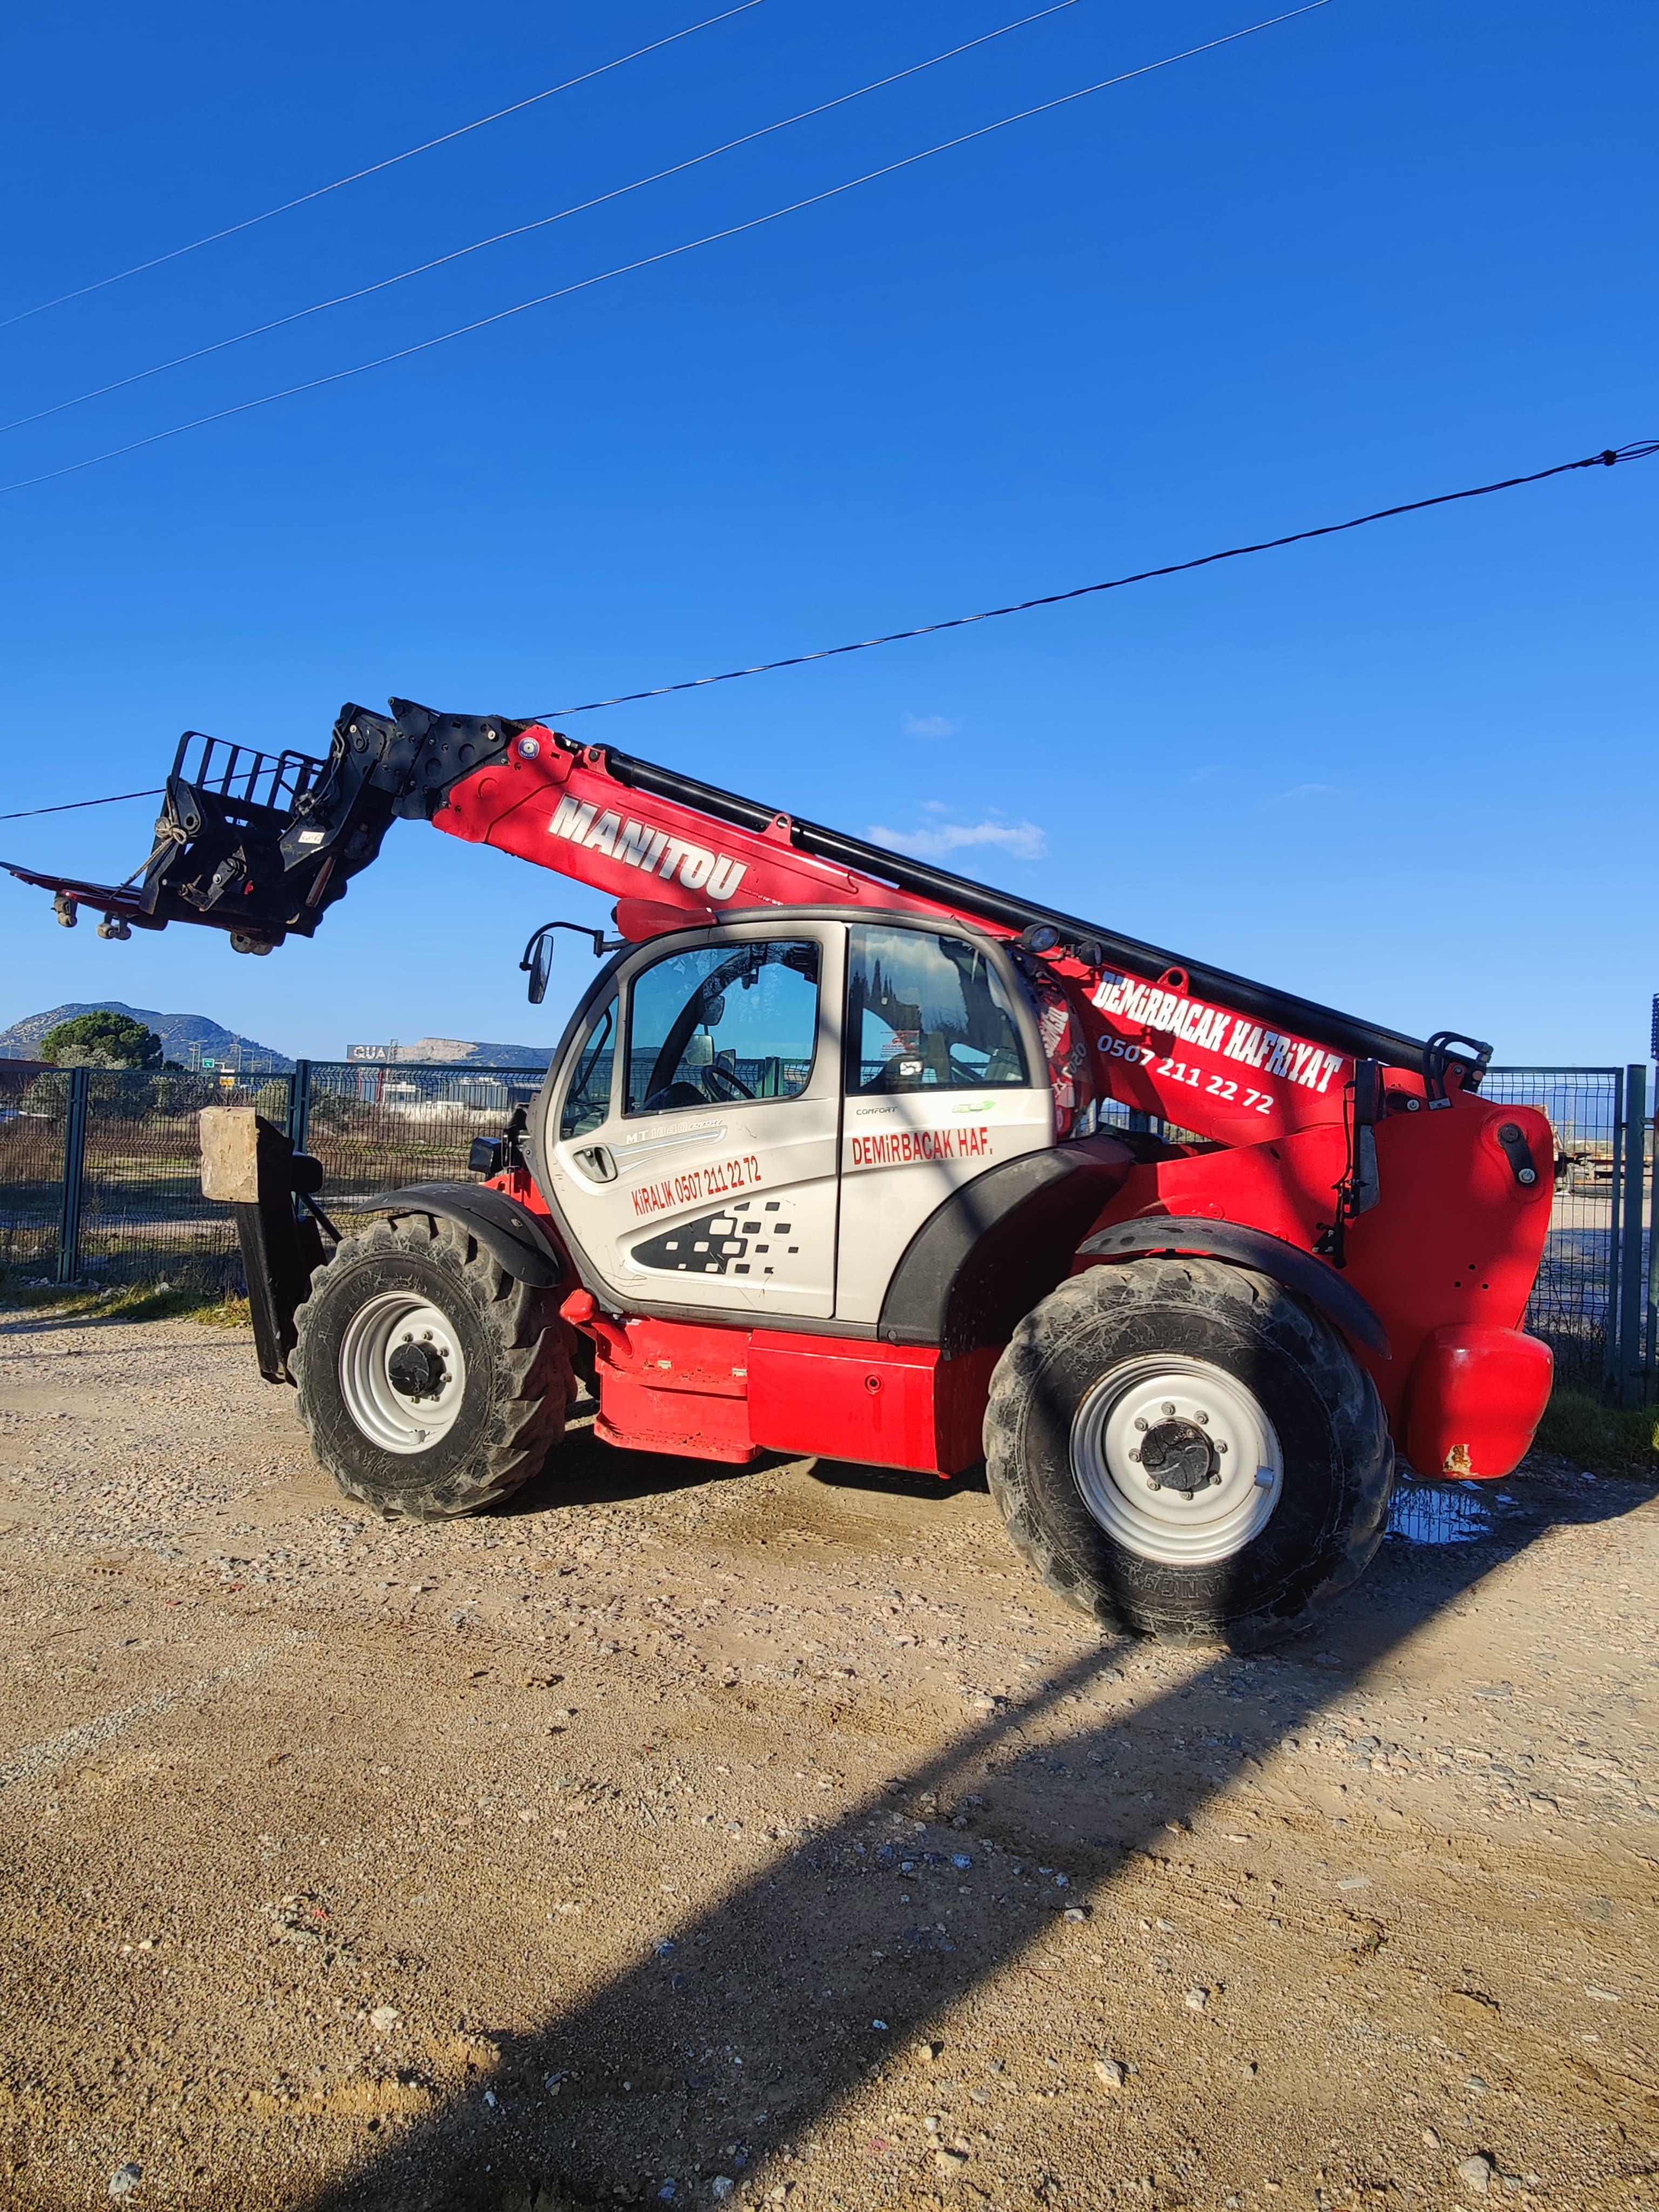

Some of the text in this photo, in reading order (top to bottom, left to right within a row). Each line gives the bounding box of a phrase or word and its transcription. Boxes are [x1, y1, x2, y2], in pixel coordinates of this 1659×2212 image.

[547, 792, 752, 900] MANITOU
[1097, 1034, 1274, 1115] 0507 211 22 72
[855, 1106, 899, 1115] COMFORT
[626, 1130, 649, 1145] MT
[650, 1122, 688, 1139] 1840
[957, 1127, 993, 1157] HAF.
[675, 1172, 703, 1203] 0507
[704, 1164, 729, 1195] 211
[727, 1160, 745, 1188] 22
[743, 1155, 761, 1183] 72
